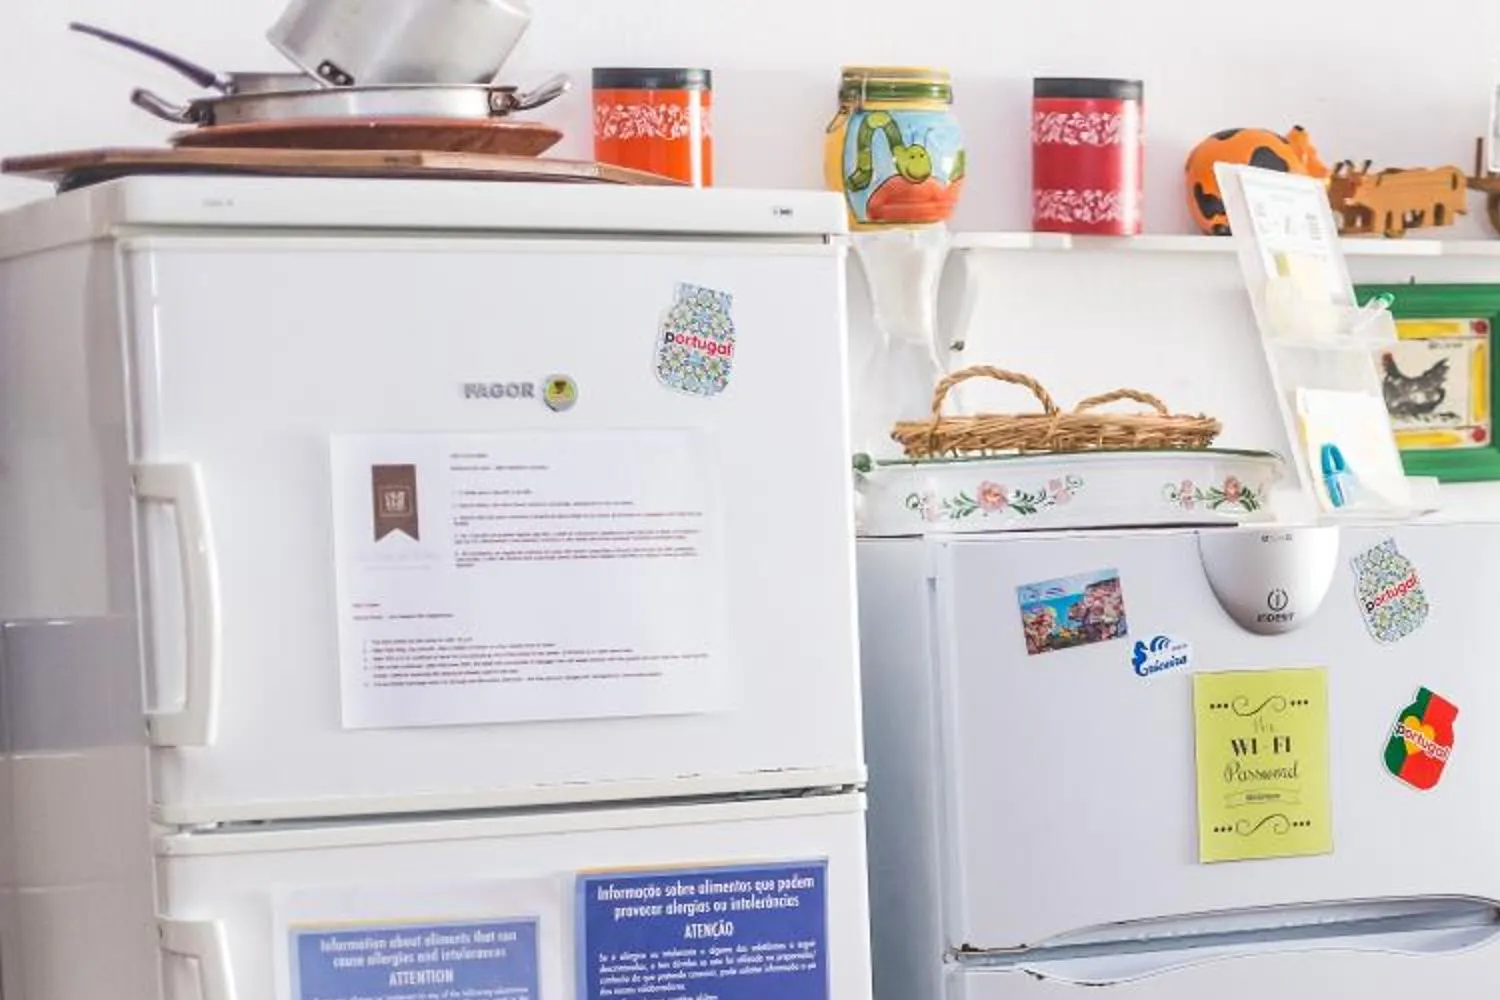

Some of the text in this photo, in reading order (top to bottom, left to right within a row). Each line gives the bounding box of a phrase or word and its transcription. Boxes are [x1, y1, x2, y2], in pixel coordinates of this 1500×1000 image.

[664, 330, 734, 358] portugal
[463, 382, 535, 400] FAGOR
[1365, 573, 1420, 614] portugal
[1395, 722, 1452, 760] portugal
[1223, 760, 1298, 783] Password
[597, 882, 662, 902] Informação
[665, 879, 695, 897] sobre
[698, 878, 753, 895] alimentos
[778, 873, 815, 892] podem
[614, 904, 663, 921] provocar
[665, 897, 711, 917] alergias
[684, 919, 734, 940] ATENÇÃO
[388, 968, 454, 987] ATTENTION
